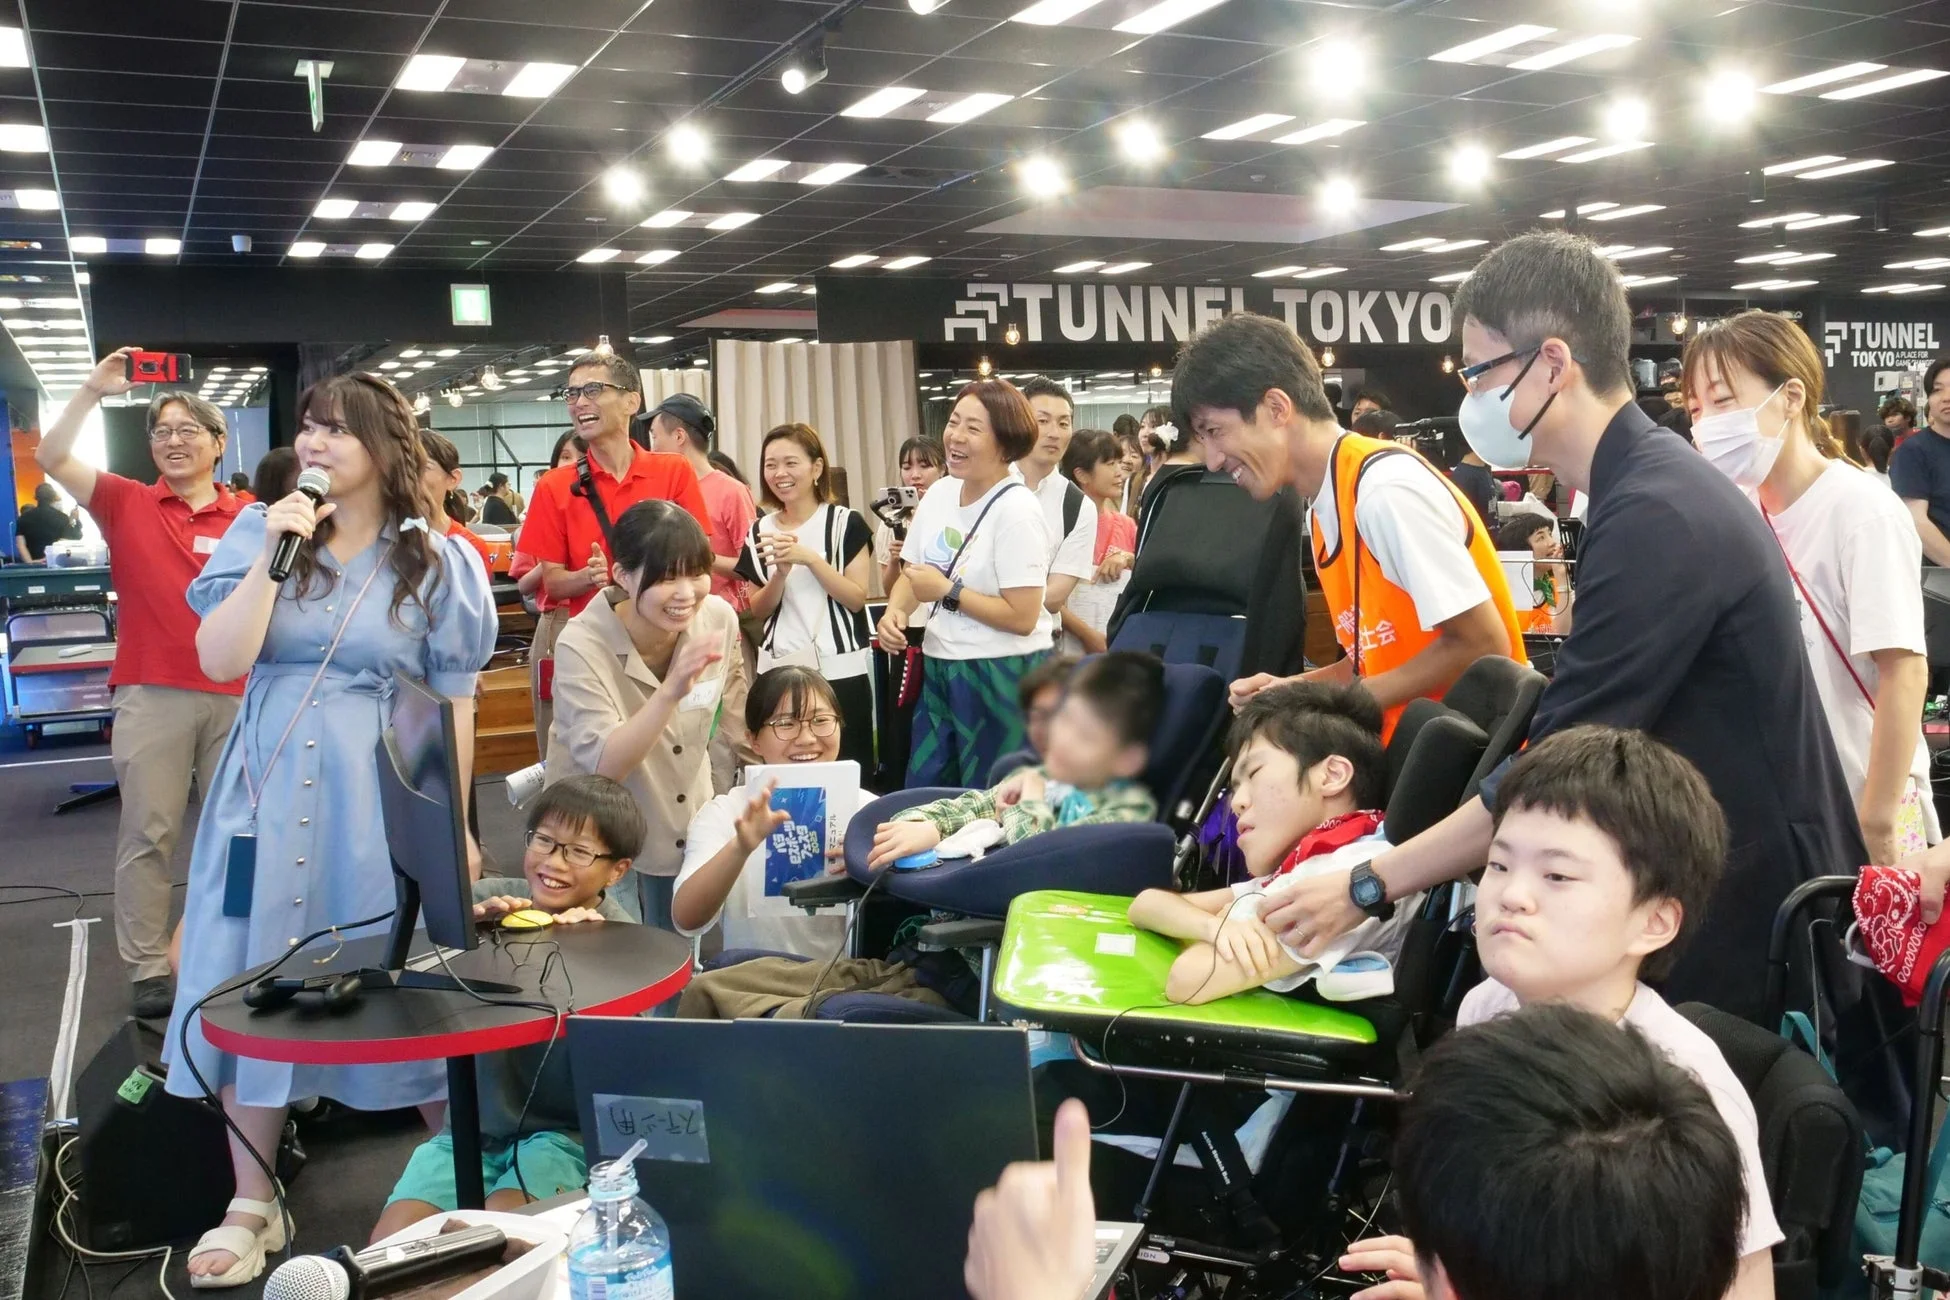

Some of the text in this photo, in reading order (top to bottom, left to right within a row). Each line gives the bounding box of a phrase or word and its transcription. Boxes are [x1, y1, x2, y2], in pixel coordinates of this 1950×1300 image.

[1273, 289, 1451, 343] TOKYO
[1851, 322, 1940, 349] TUNNEL
[1851, 351, 1894, 367] TOKYO
[772, 833, 787, 854] パラ
[796, 825, 813, 860] フェスタ
[610, 1106, 700, 1138] ステージ用
